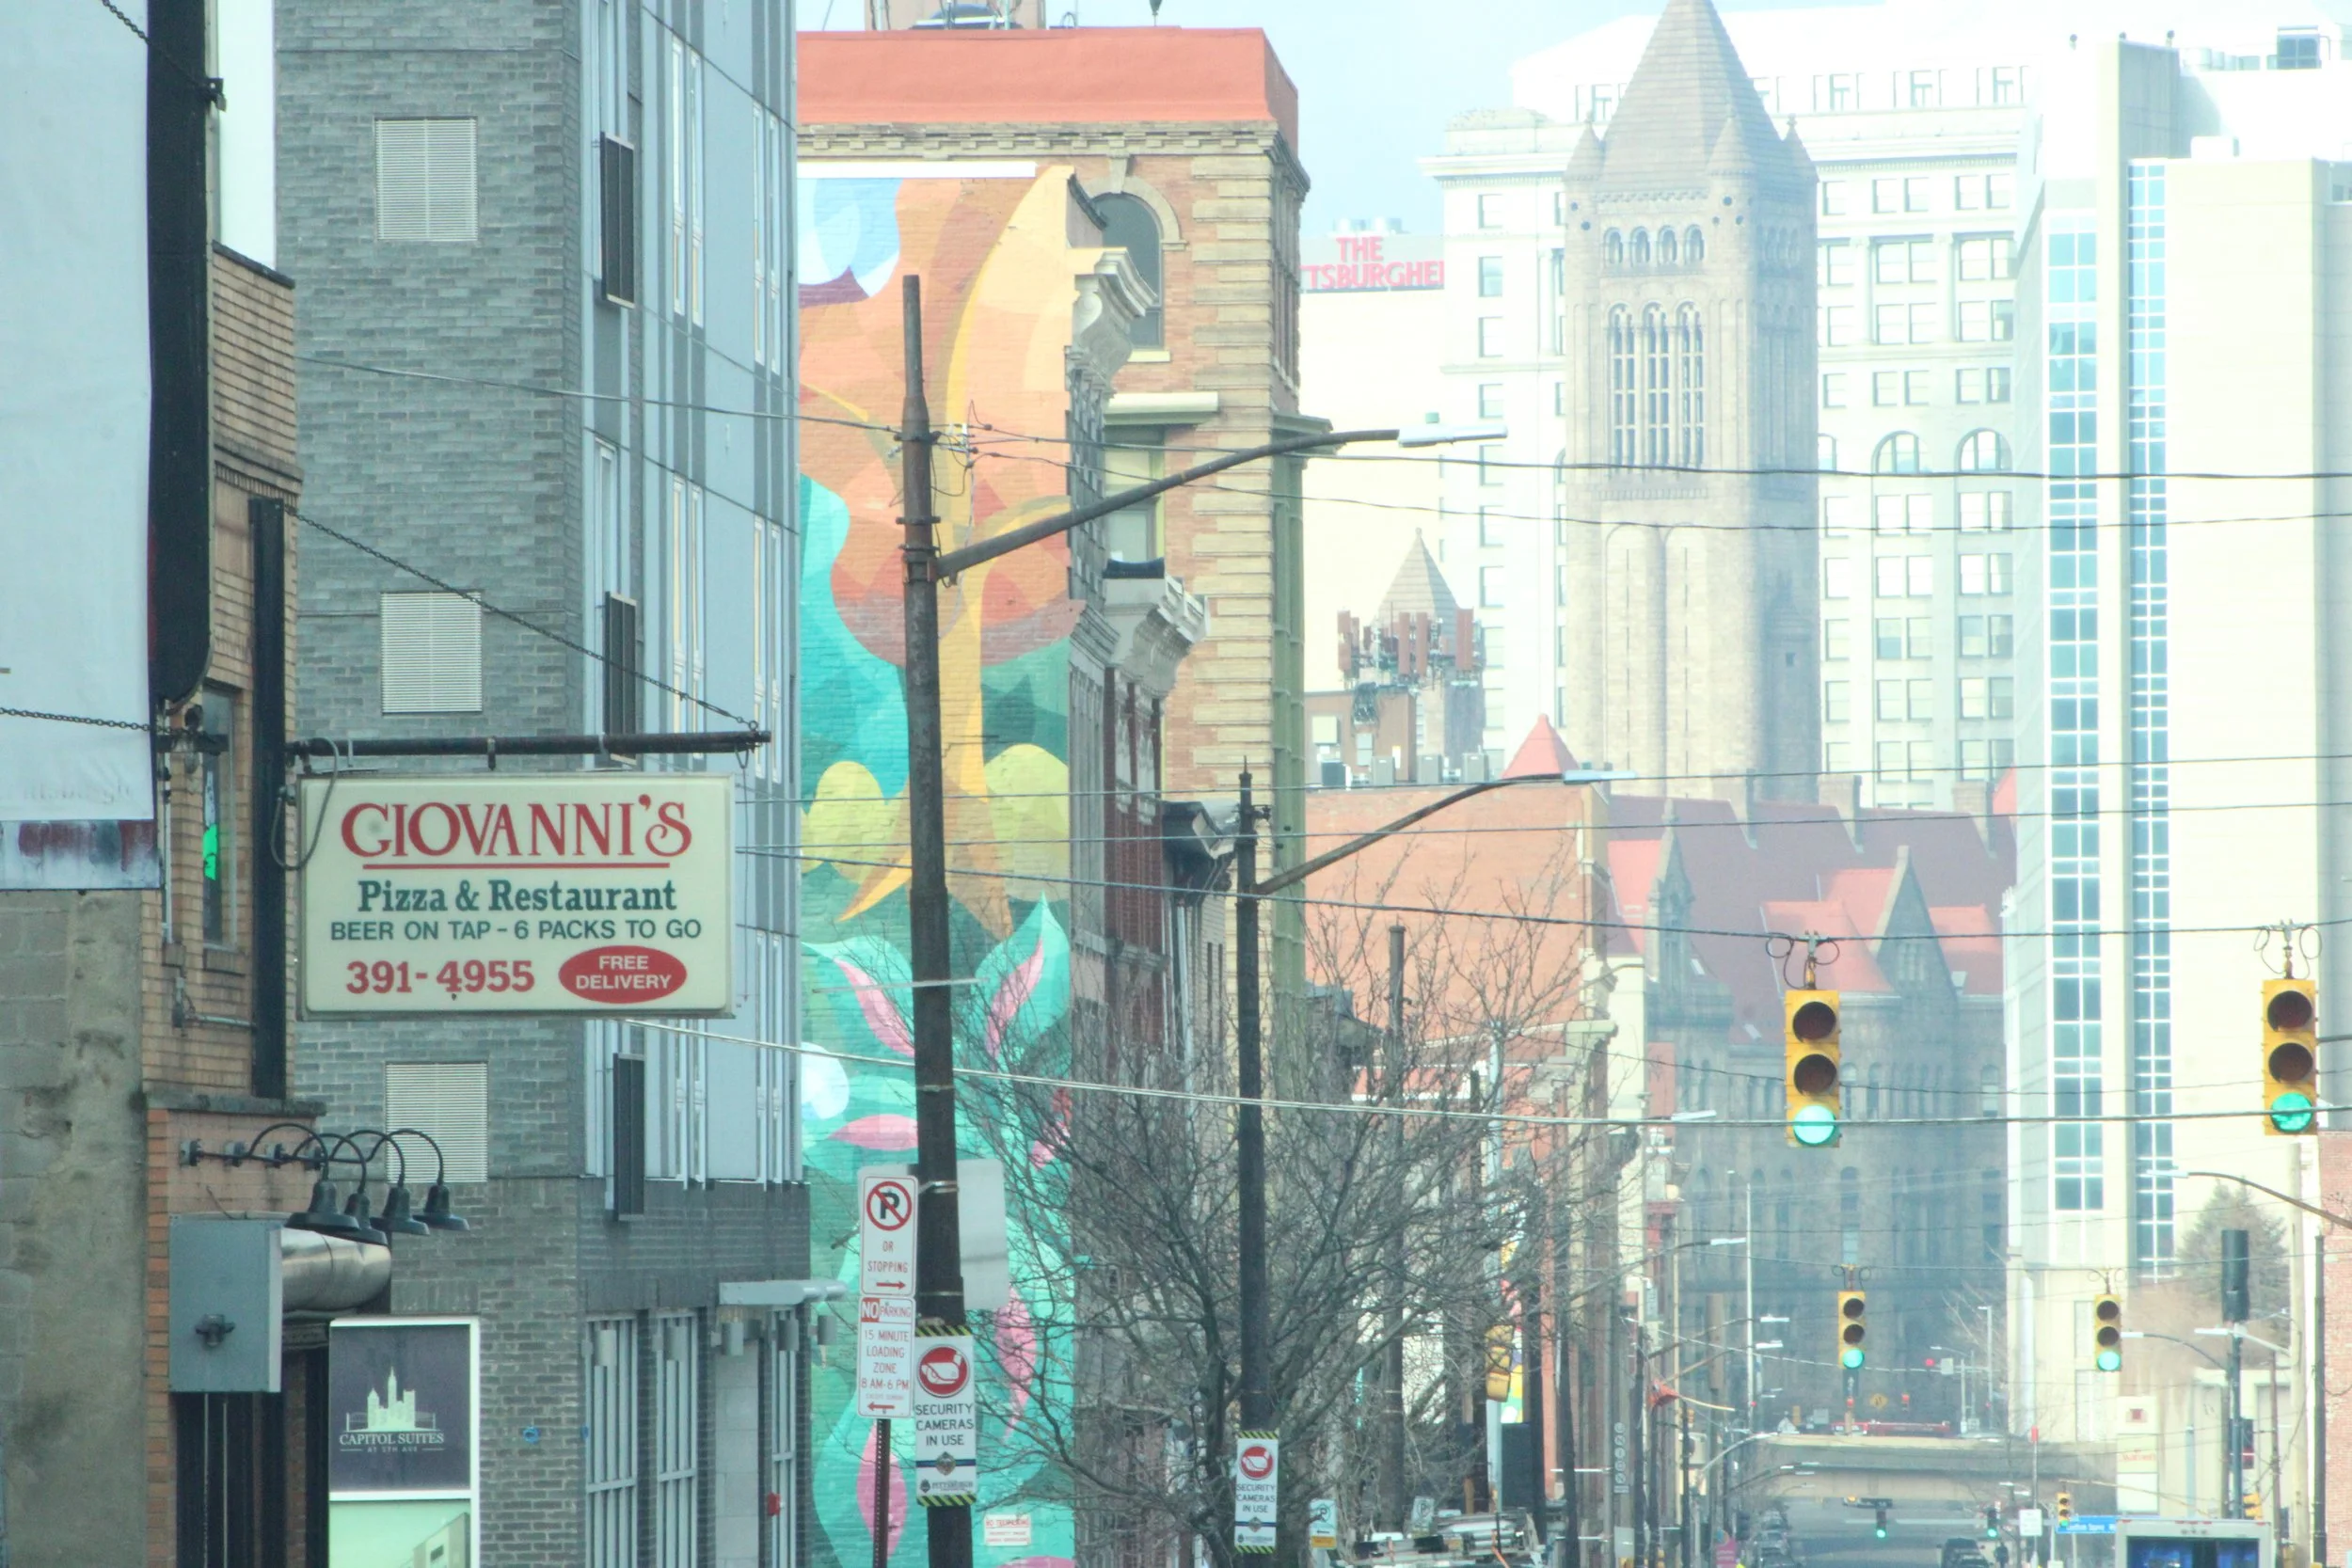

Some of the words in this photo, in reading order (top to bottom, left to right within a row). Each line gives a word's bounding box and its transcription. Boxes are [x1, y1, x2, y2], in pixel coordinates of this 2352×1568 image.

[1336, 236, 1384, 262] THE
[341, 794, 692, 857] GIOVANNI'S
[358, 879, 448, 912] Pizza
[455, 879, 480, 911] &
[488, 879, 677, 912] Restaurant
[331, 921, 394, 941] BEER
[405, 921, 438, 941] ON
[451, 920, 491, 940] TAP
[515, 920, 530, 940] 6
[538, 919, 616, 940] PACKS
[628, 918, 657, 939] TO
[666, 918, 702, 939] GO
[598, 955, 649, 971] FREE
[345, 958, 535, 994] 391-4955
[575, 973, 673, 990] DELIVERY
[882, 1241, 894, 1253] OR
[867, 1260, 909, 1274] STOPPING
[861, 1302, 880, 1320] NO
[880, 1305, 912, 1318] PARKING
[865, 1329, 875, 1340] 15
[878, 1330, 910, 1343] MINUTE
[866, 1346, 905, 1358] LOADING
[873, 1362, 898, 1374] ZONE
[861, 1379, 867, 1388] 8
[896, 1380, 910, 1390] PM
[915, 1403, 973, 1416] SECURITY
[915, 1418, 975, 1432] CAMERAS
[339, 1433, 396, 1446] CAPITOL
[398, 1433, 445, 1445] SUITES
[926, 1434, 938, 1447] IN
[942, 1433, 964, 1447] USE
[1236, 1494, 1275, 1502] CAMERAS
